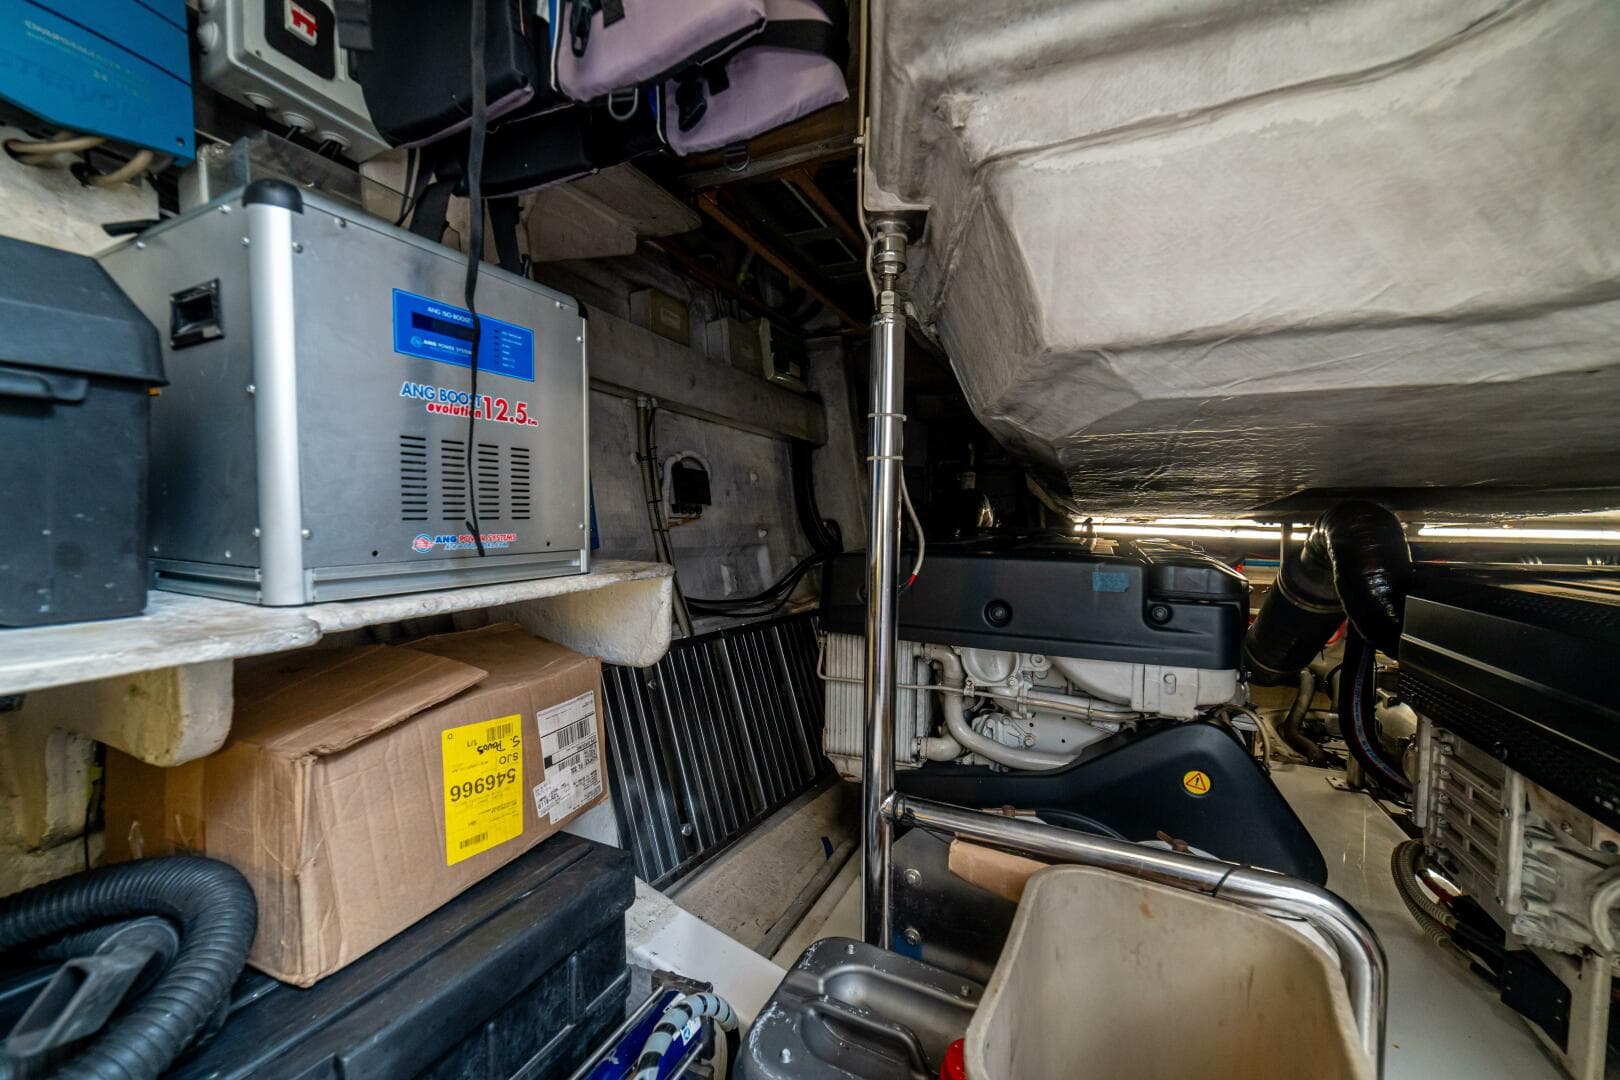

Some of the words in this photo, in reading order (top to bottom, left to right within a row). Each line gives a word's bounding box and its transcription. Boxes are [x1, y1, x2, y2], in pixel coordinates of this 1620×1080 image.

[400, 382, 436, 400] ANG
[483, 395, 529, 425] 12.5
[459, 534, 485, 543] POR
[498, 752, 519, 765] SJO
[450, 767, 517, 802] 546966
